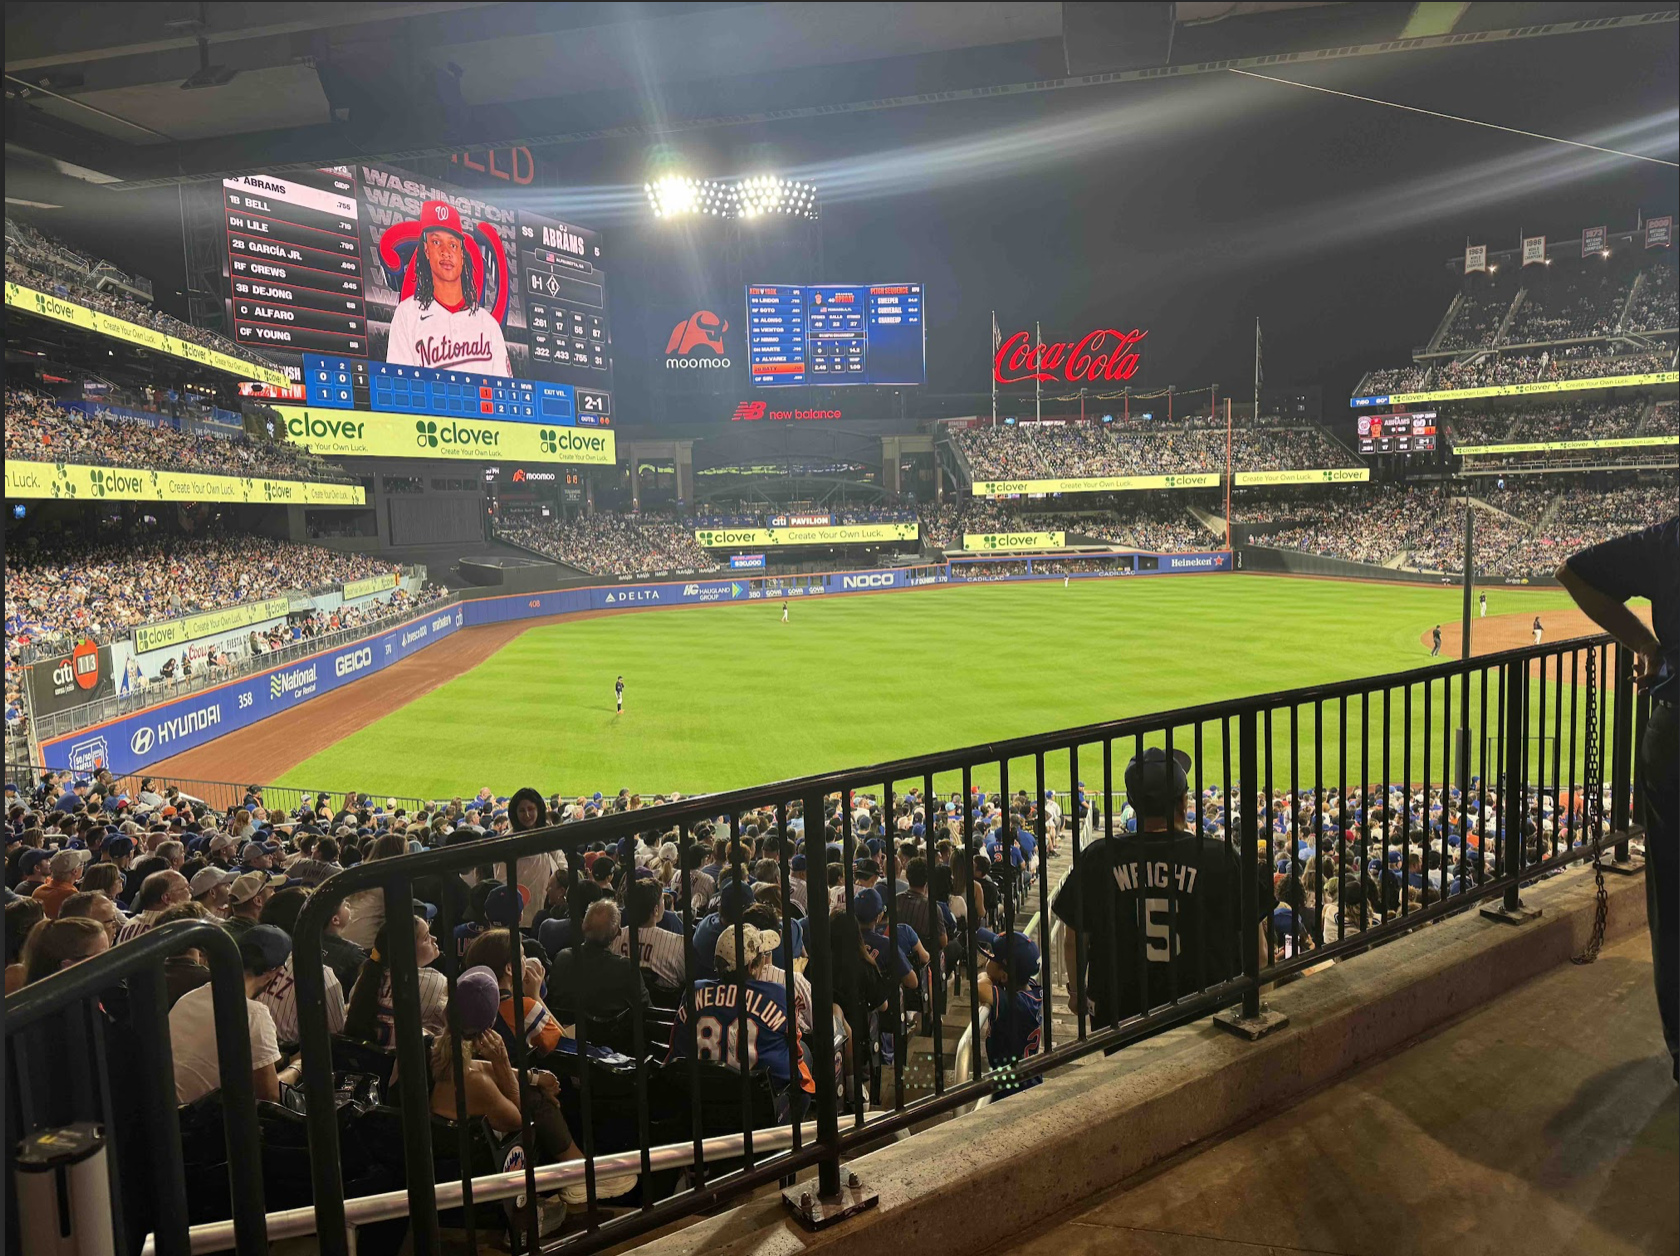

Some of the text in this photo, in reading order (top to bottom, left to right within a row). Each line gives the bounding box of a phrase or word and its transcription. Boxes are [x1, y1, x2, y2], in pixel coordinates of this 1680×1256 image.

[244, 175, 286, 195] ABRAMS
[229, 194, 270, 212] 1B BELL
[229, 217, 269, 233] DH LILE
[522, 226, 600, 256] SS ABRAMS 5
[232, 240, 302, 262] 2B GARCÍA JR.
[1468, 248, 1484, 256] 1969
[234, 260, 286, 278] RF CREWS
[236, 283, 293, 300] 3B DEJONG
[46, 298, 74, 320] clover
[241, 306, 294, 321] C ALFARO
[104, 319, 144, 340] Create Your Own
[240, 326, 292, 341] CF YOUNG
[556, 322, 564, 330] 17
[188, 346, 206, 360] clover
[416, 332, 492, 367] Nationals
[534, 347, 550, 357] .322
[554, 350, 570, 360] .433
[994, 328, 1148, 383] Coca-Cola
[594, 356, 602, 366] 31
[666, 357, 730, 368] moomoo
[320, 360, 324, 368] 1
[340, 362, 346, 370] 2
[358, 364, 363, 372] 3
[398, 368, 403, 376] 5
[450, 374, 456, 382] 8
[320, 372, 327, 381] 0
[340, 375, 346, 383] 0
[358, 376, 364, 384] 1
[512, 392, 516, 400] 1
[544, 388, 555, 396] EXIT
[1524, 383, 1551, 392] clover
[322, 390, 328, 398] 1
[341, 391, 348, 399] 0
[513, 406, 518, 414] 1
[584, 396, 603, 411] 2-1
[1401, 394, 1424, 402] clover
[770, 409, 841, 420] new balance
[1384, 418, 1410, 426] ABRAMS
[288, 412, 364, 439] clover
[440, 422, 500, 446] clover
[558, 430, 606, 452] clover
[315, 442, 331, 452] Your
[440, 447, 488, 457] Create Your Own
[12, 470, 41, 488] Luck.
[106, 470, 143, 494] clover
[526, 472, 556, 481] moomoo
[1176, 476, 1207, 486] clover
[1333, 470, 1362, 480] clover
[169, 480, 235, 496] Create Your Own Luck.
[272, 482, 292, 499] clover
[996, 483, 1028, 493] clover
[772, 516, 829, 526] citi PAVILION
[714, 530, 756, 544] clover
[788, 529, 884, 541] Create Your Own Luck.
[998, 534, 1038, 547] clover
[1171, 557, 1212, 568] Heineken
[844, 572, 895, 589] NOCO
[618, 590, 660, 602] DELTA
[699, 586, 730, 596] HAUGLAND
[748, 591, 761, 599] 380
[271, 600, 288, 616] clover
[528, 600, 541, 609] 408
[193, 616, 231, 633] Create Your Own
[148, 626, 175, 644] clover
[188, 644, 208, 660] Coors
[77, 656, 96, 674] 113
[336, 646, 372, 678] GEICO
[53, 664, 73, 686] citi
[280, 663, 317, 694] National
[294, 684, 316, 699] Car Rental
[238, 692, 253, 710] 358
[158, 704, 221, 746] HYUNDAI
[76, 752, 92, 765] 50/50
[1137, 898, 1181, 962] 5
[620, 942, 654, 963] STO
[745, 989, 788, 1032] ALUM
[696, 1016, 759, 1072] 80
